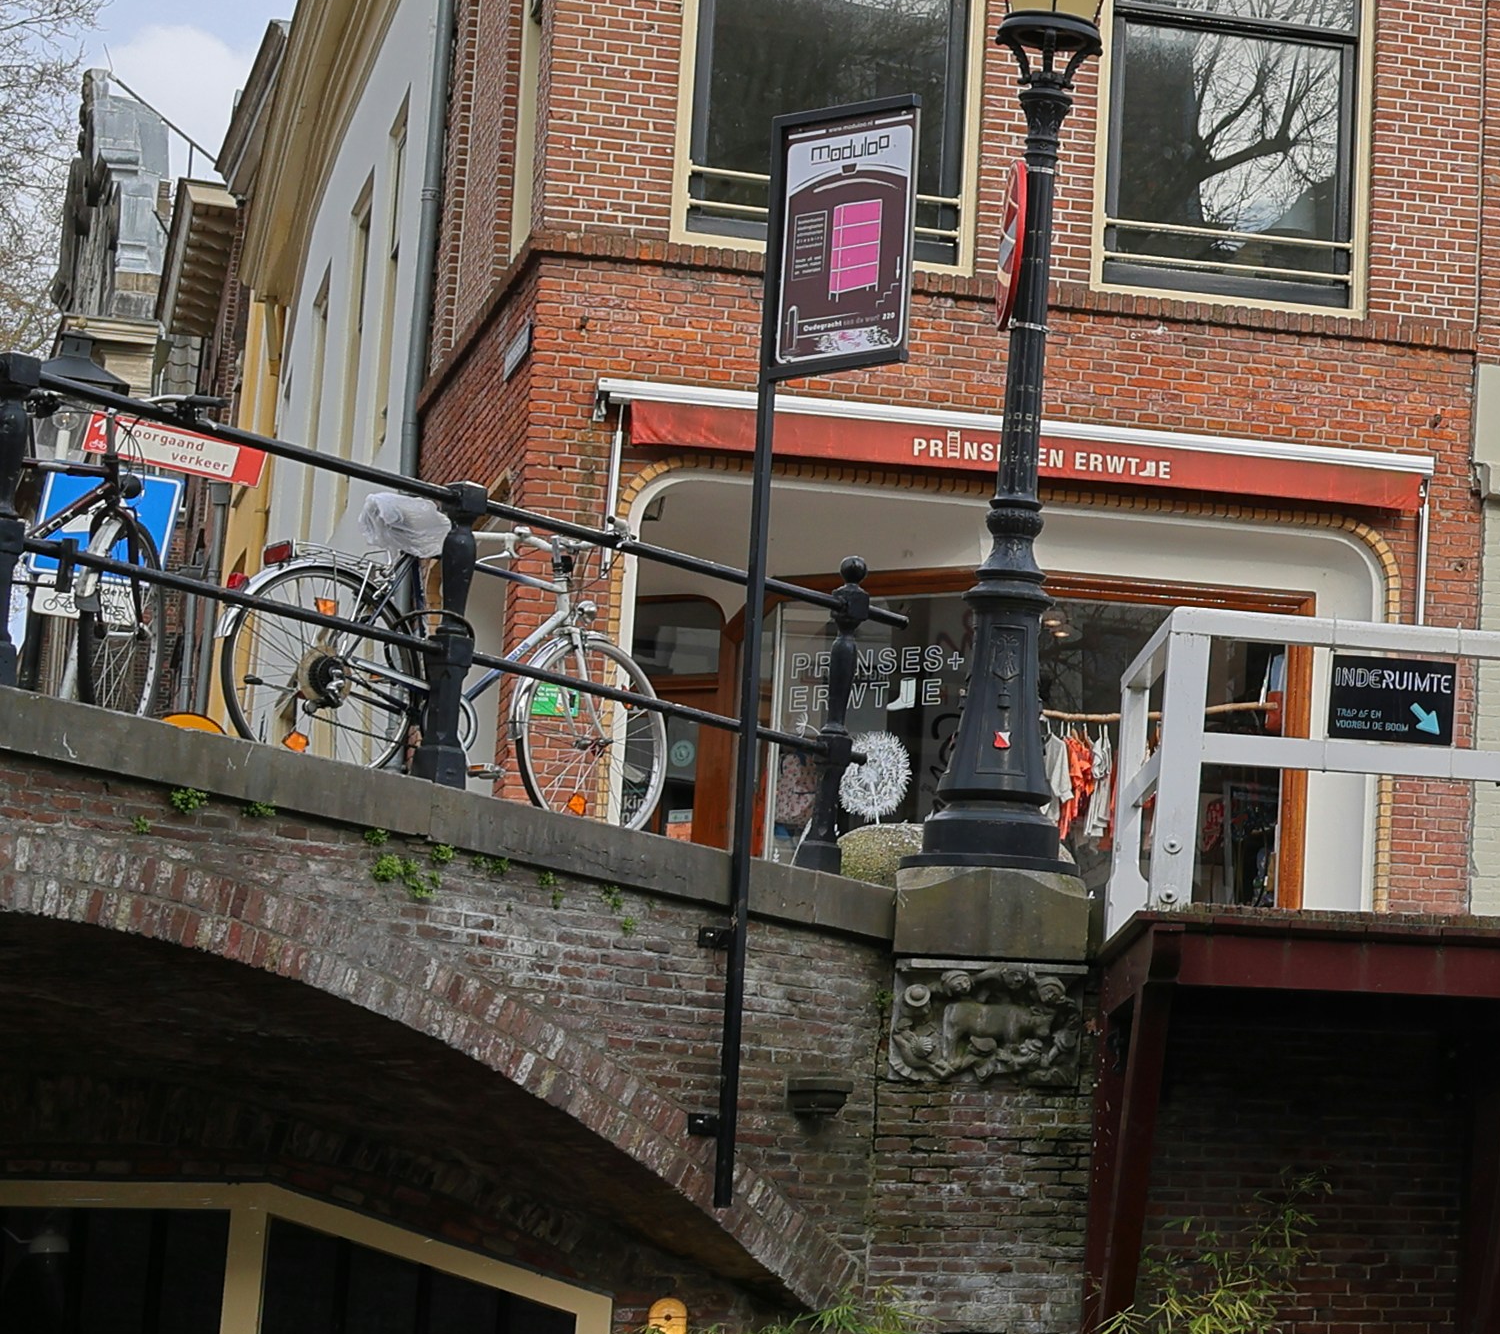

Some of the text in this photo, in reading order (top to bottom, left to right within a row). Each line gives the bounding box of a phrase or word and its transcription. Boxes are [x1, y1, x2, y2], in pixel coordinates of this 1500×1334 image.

[803, 320, 842, 332] Oudegracht
[171, 452, 229, 473] verkeer
[1337, 708, 1382, 719] TRAP AF EN
[1335, 719, 1409, 732] VOORBIJ DE BOOM
